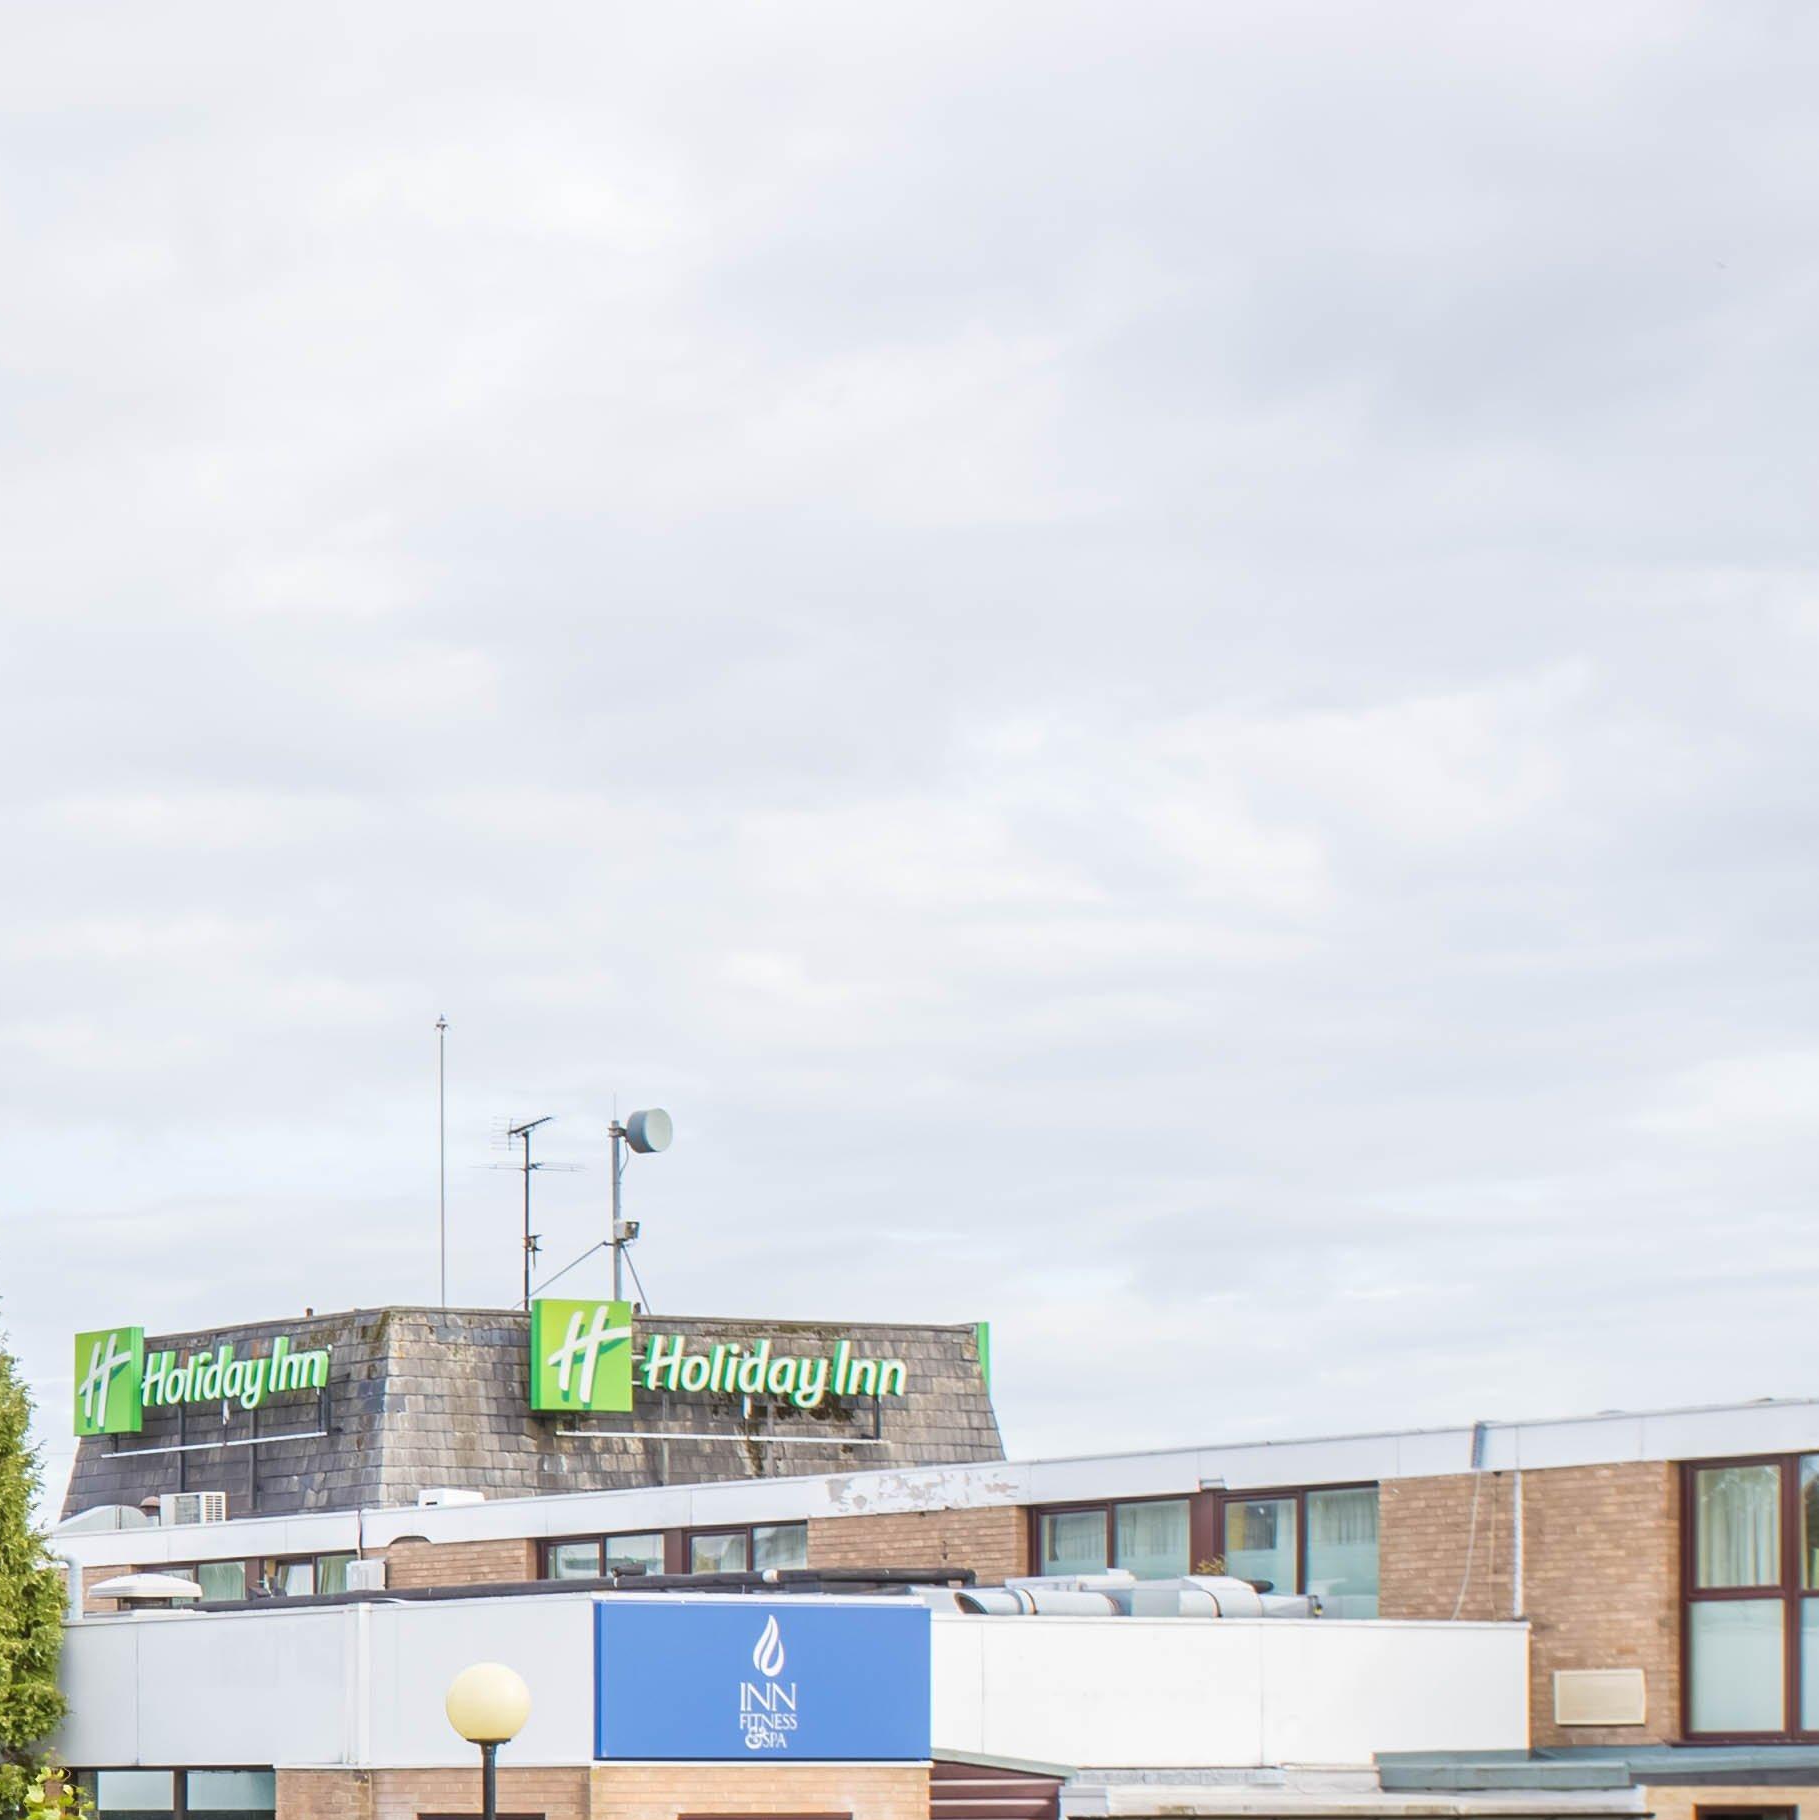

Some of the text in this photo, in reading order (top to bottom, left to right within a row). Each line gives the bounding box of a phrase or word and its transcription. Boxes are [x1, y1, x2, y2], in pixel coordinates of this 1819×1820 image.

[141, 1336, 329, 1410] Holiday Inn
[641, 1334, 907, 1408] Holiday Inn
[739, 1713, 798, 1730] FITNESS
[740, 1681, 797, 1712] INN
